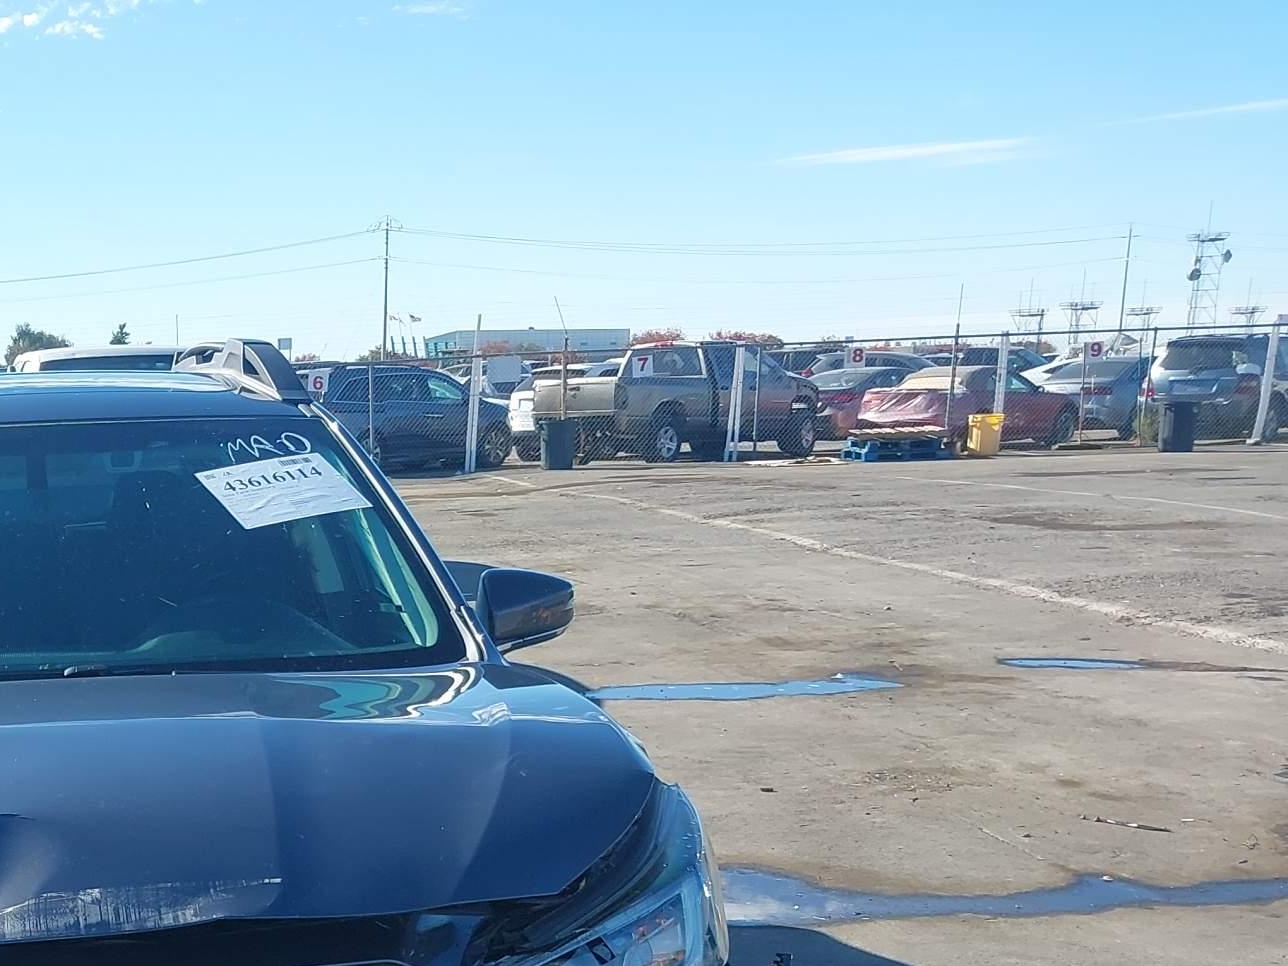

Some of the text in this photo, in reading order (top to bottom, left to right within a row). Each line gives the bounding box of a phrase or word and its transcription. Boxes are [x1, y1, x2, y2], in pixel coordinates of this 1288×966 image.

[852, 348, 864, 363] 8
[1090, 342, 1103, 358] 9
[637, 356, 649, 372] 7
[312, 375, 324, 391] 6
[223, 465, 323, 492] 43616114
